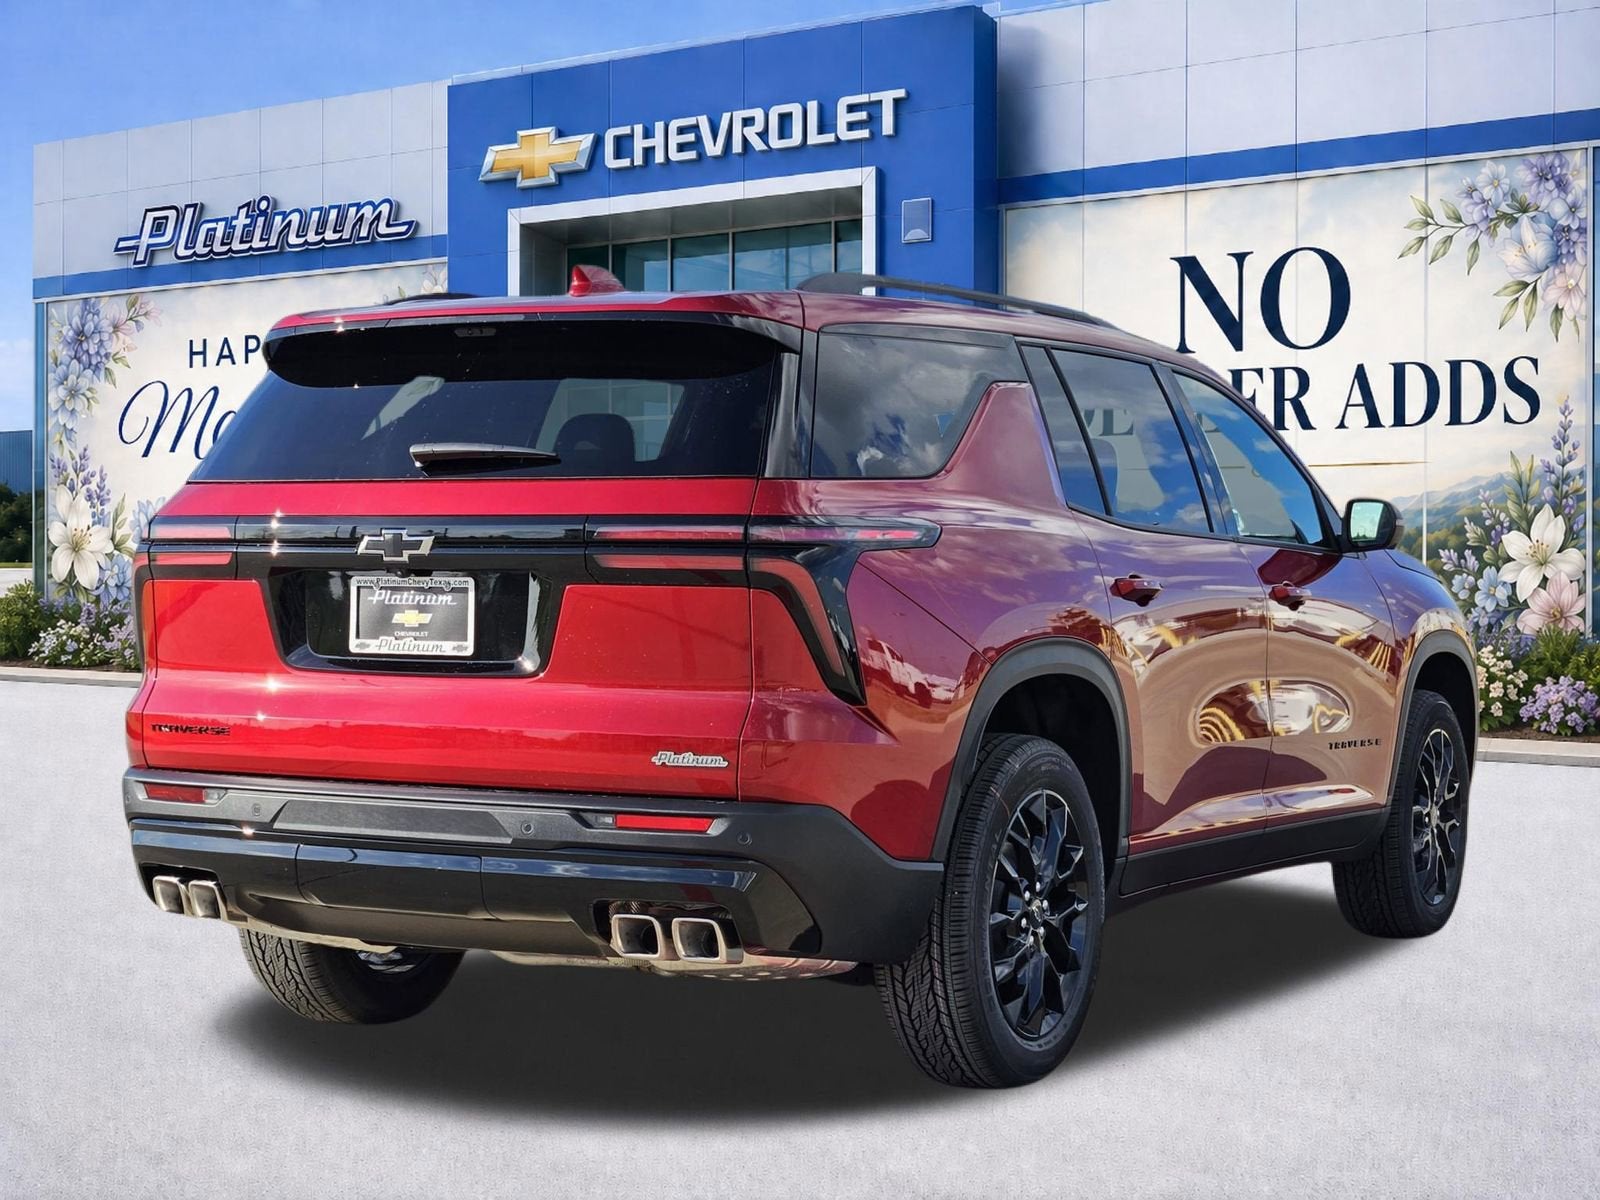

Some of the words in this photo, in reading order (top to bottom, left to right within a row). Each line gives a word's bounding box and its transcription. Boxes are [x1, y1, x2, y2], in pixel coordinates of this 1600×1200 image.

[604, 88, 907, 170] CHEVROLET
[113, 193, 417, 268] Platinum
[1170, 246, 1351, 354] NO
[1335, 355, 1541, 430] ADDS
[367, 590, 457, 605] Platinum
[375, 638, 446, 653] Platinum
[651, 751, 729, 767] Platinum
